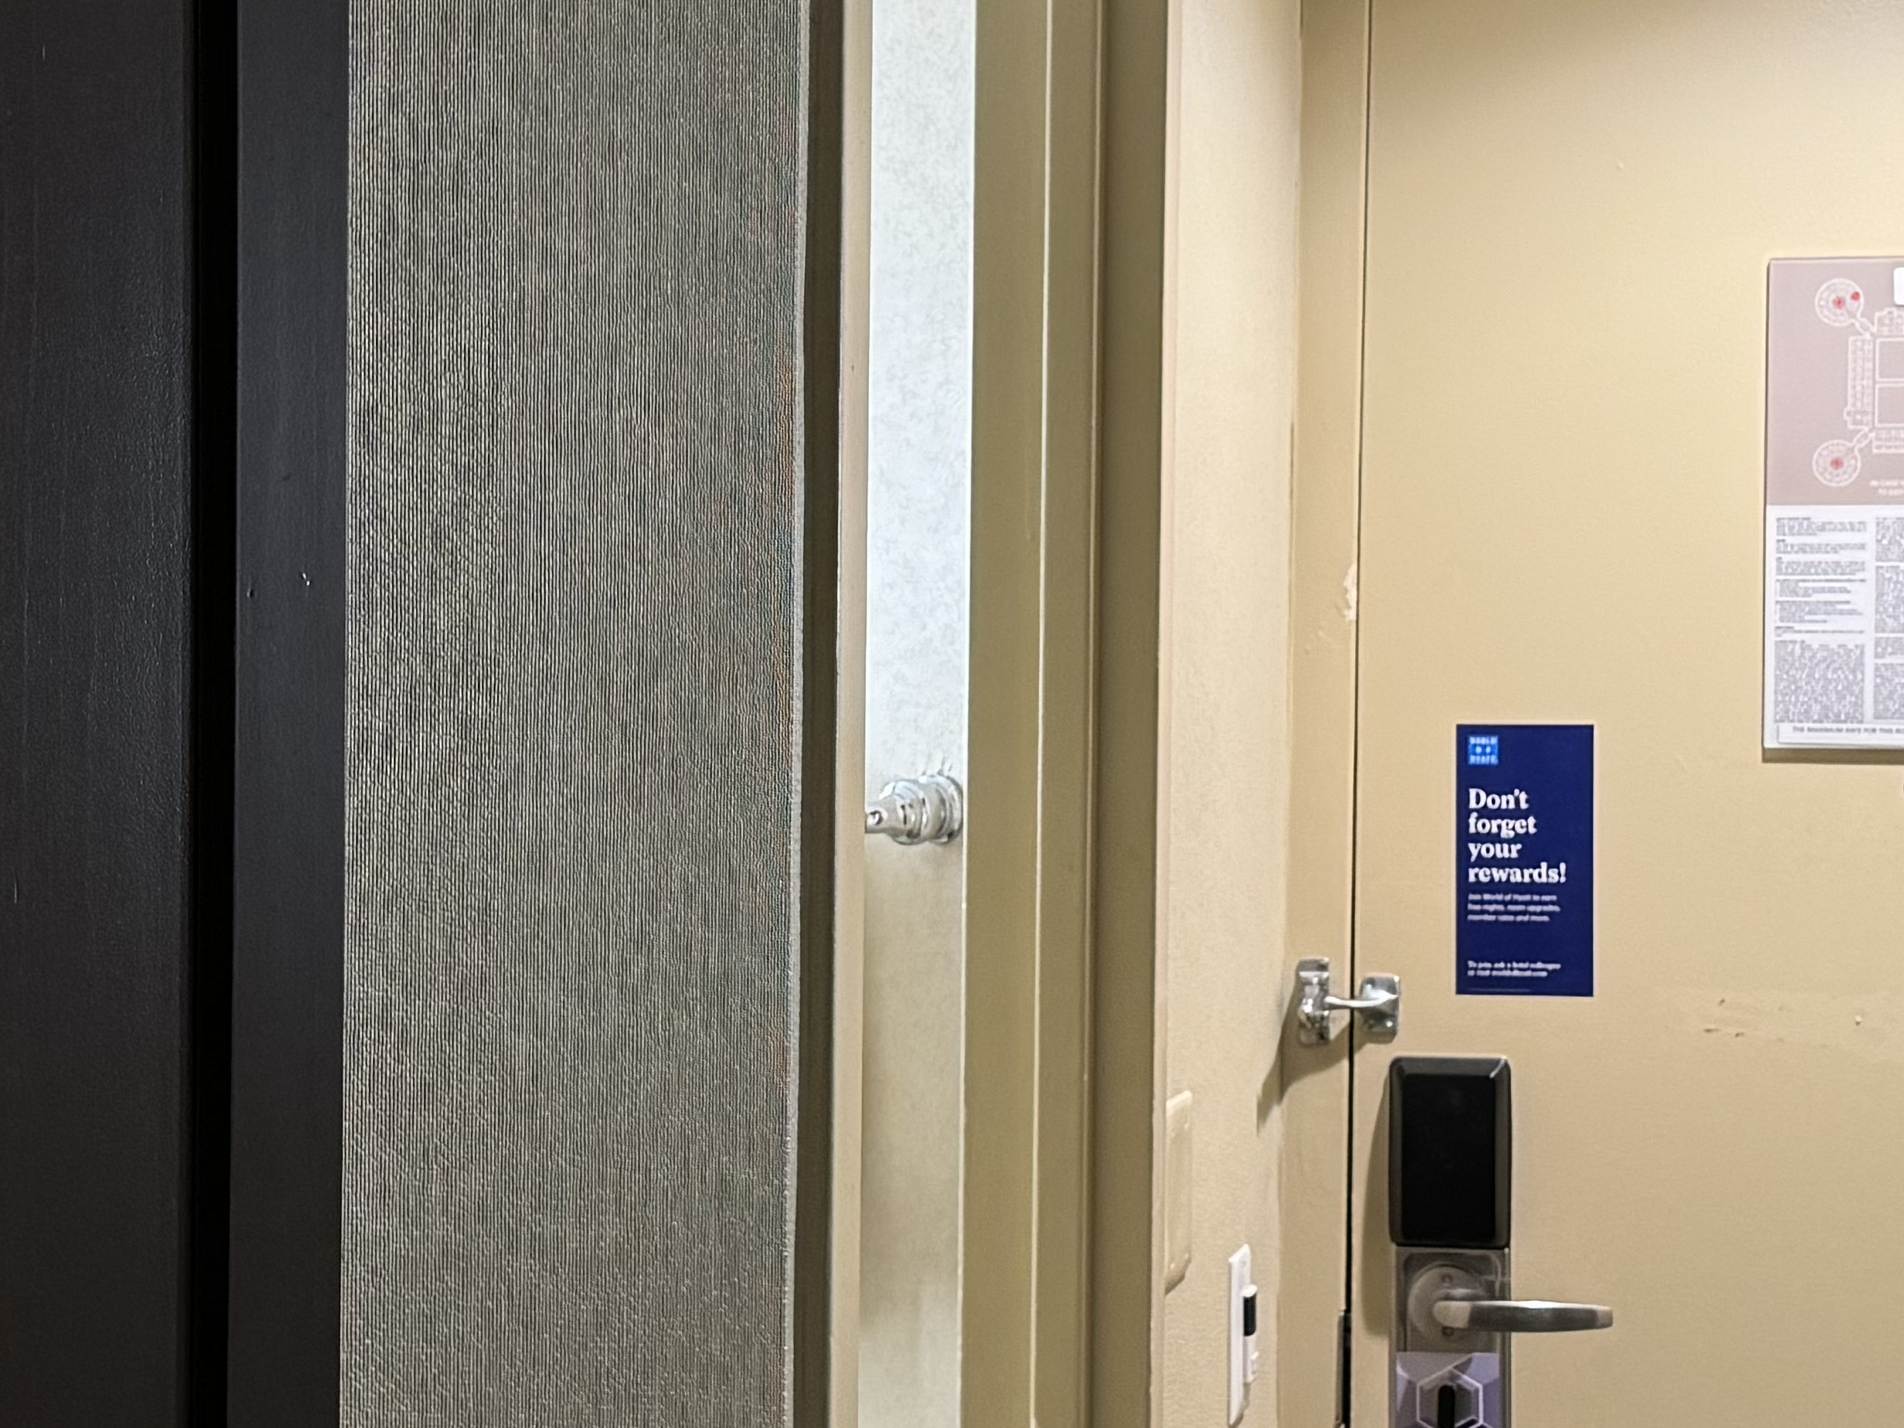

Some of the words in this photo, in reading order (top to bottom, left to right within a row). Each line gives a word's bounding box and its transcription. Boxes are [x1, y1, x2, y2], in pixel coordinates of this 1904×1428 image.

[1468, 787, 1530, 810] Don't
[1468, 811, 1538, 839] forget
[1467, 842, 1523, 863] your
[1467, 861, 1567, 884] rewards!
